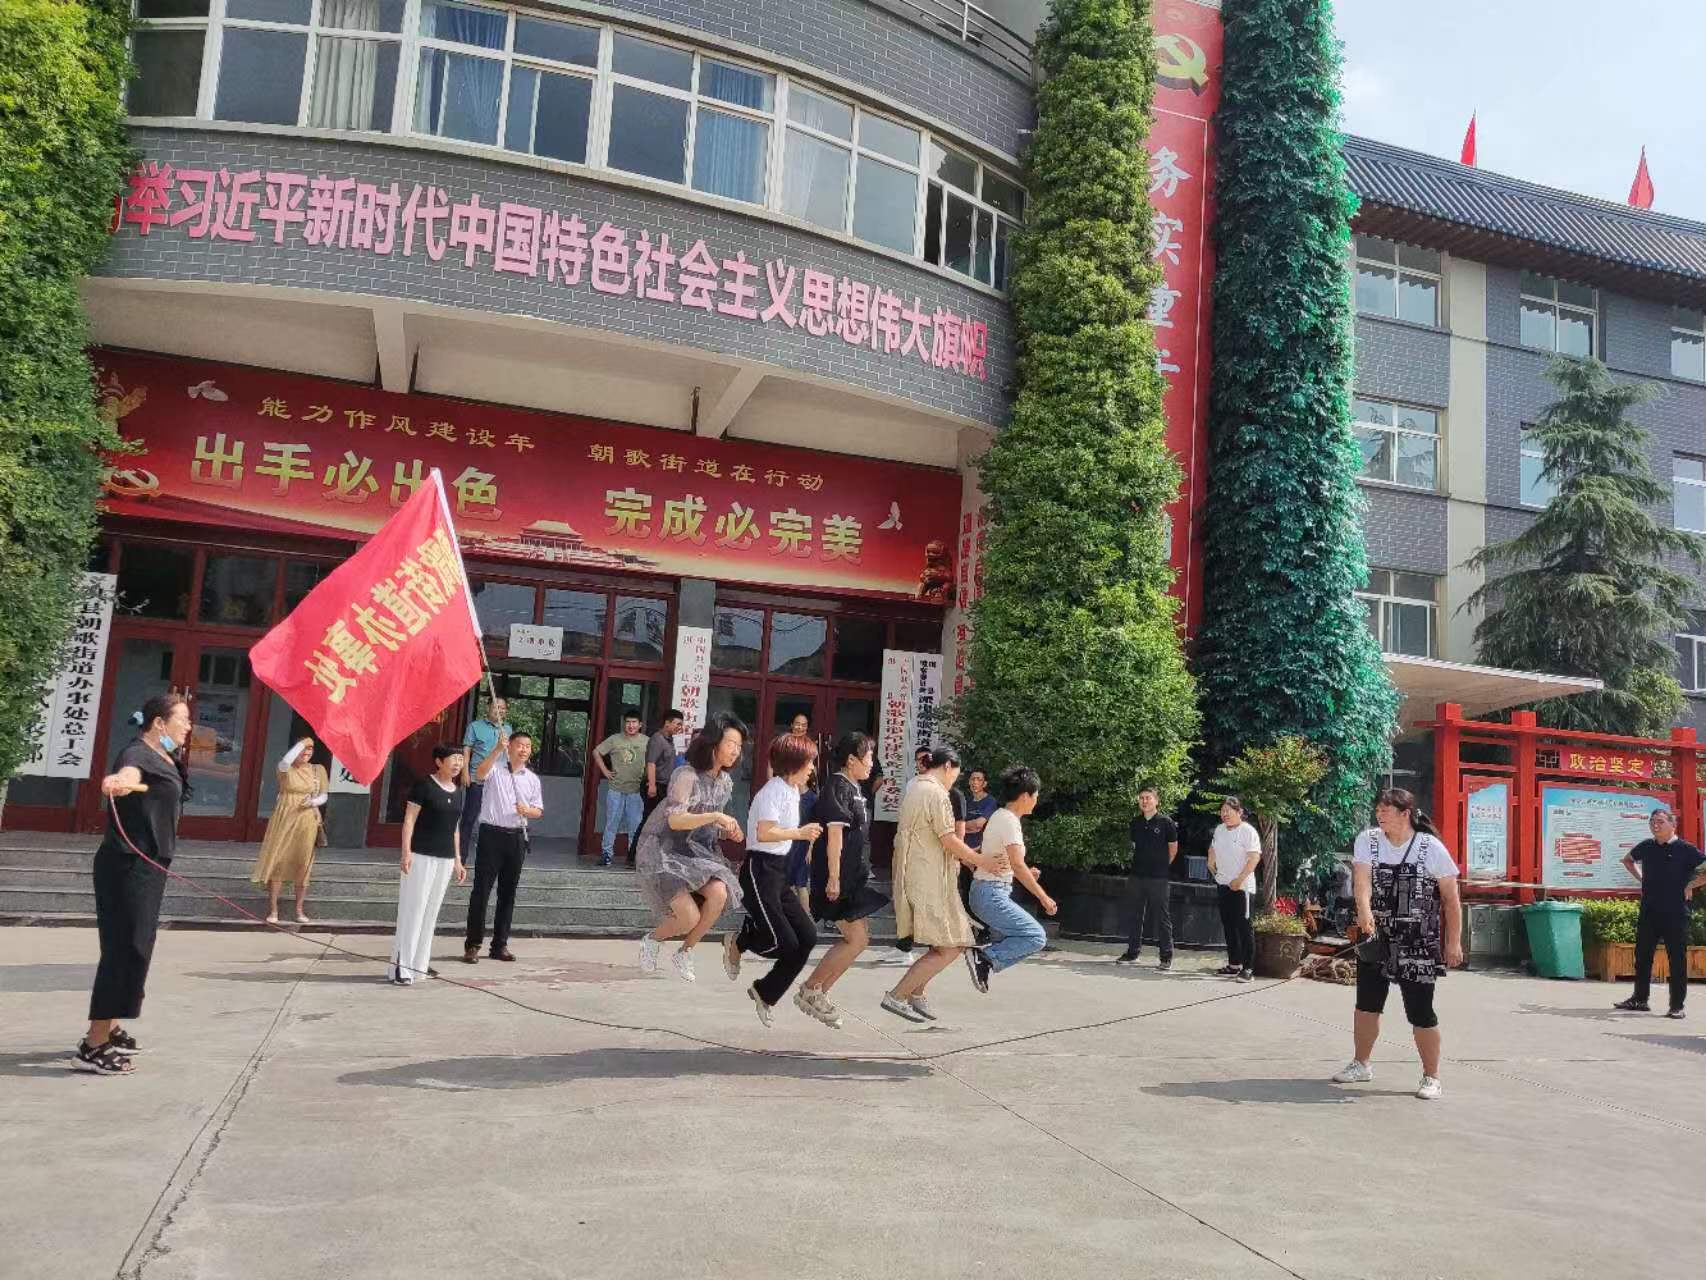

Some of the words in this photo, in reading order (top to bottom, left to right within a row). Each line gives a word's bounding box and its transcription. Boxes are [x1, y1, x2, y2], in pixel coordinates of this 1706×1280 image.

[111, 161, 988, 382] 举习近平新时代中国特色社会主义思想伟大旗帜
[190, 431, 503, 522] 出手必出色
[604, 486, 865, 566] 完成必完美
[256, 396, 536, 454] 能力作风建设年
[587, 443, 826, 492] 朝歌街道在行动
[1568, 752, 1645, 776] 政治坚定
